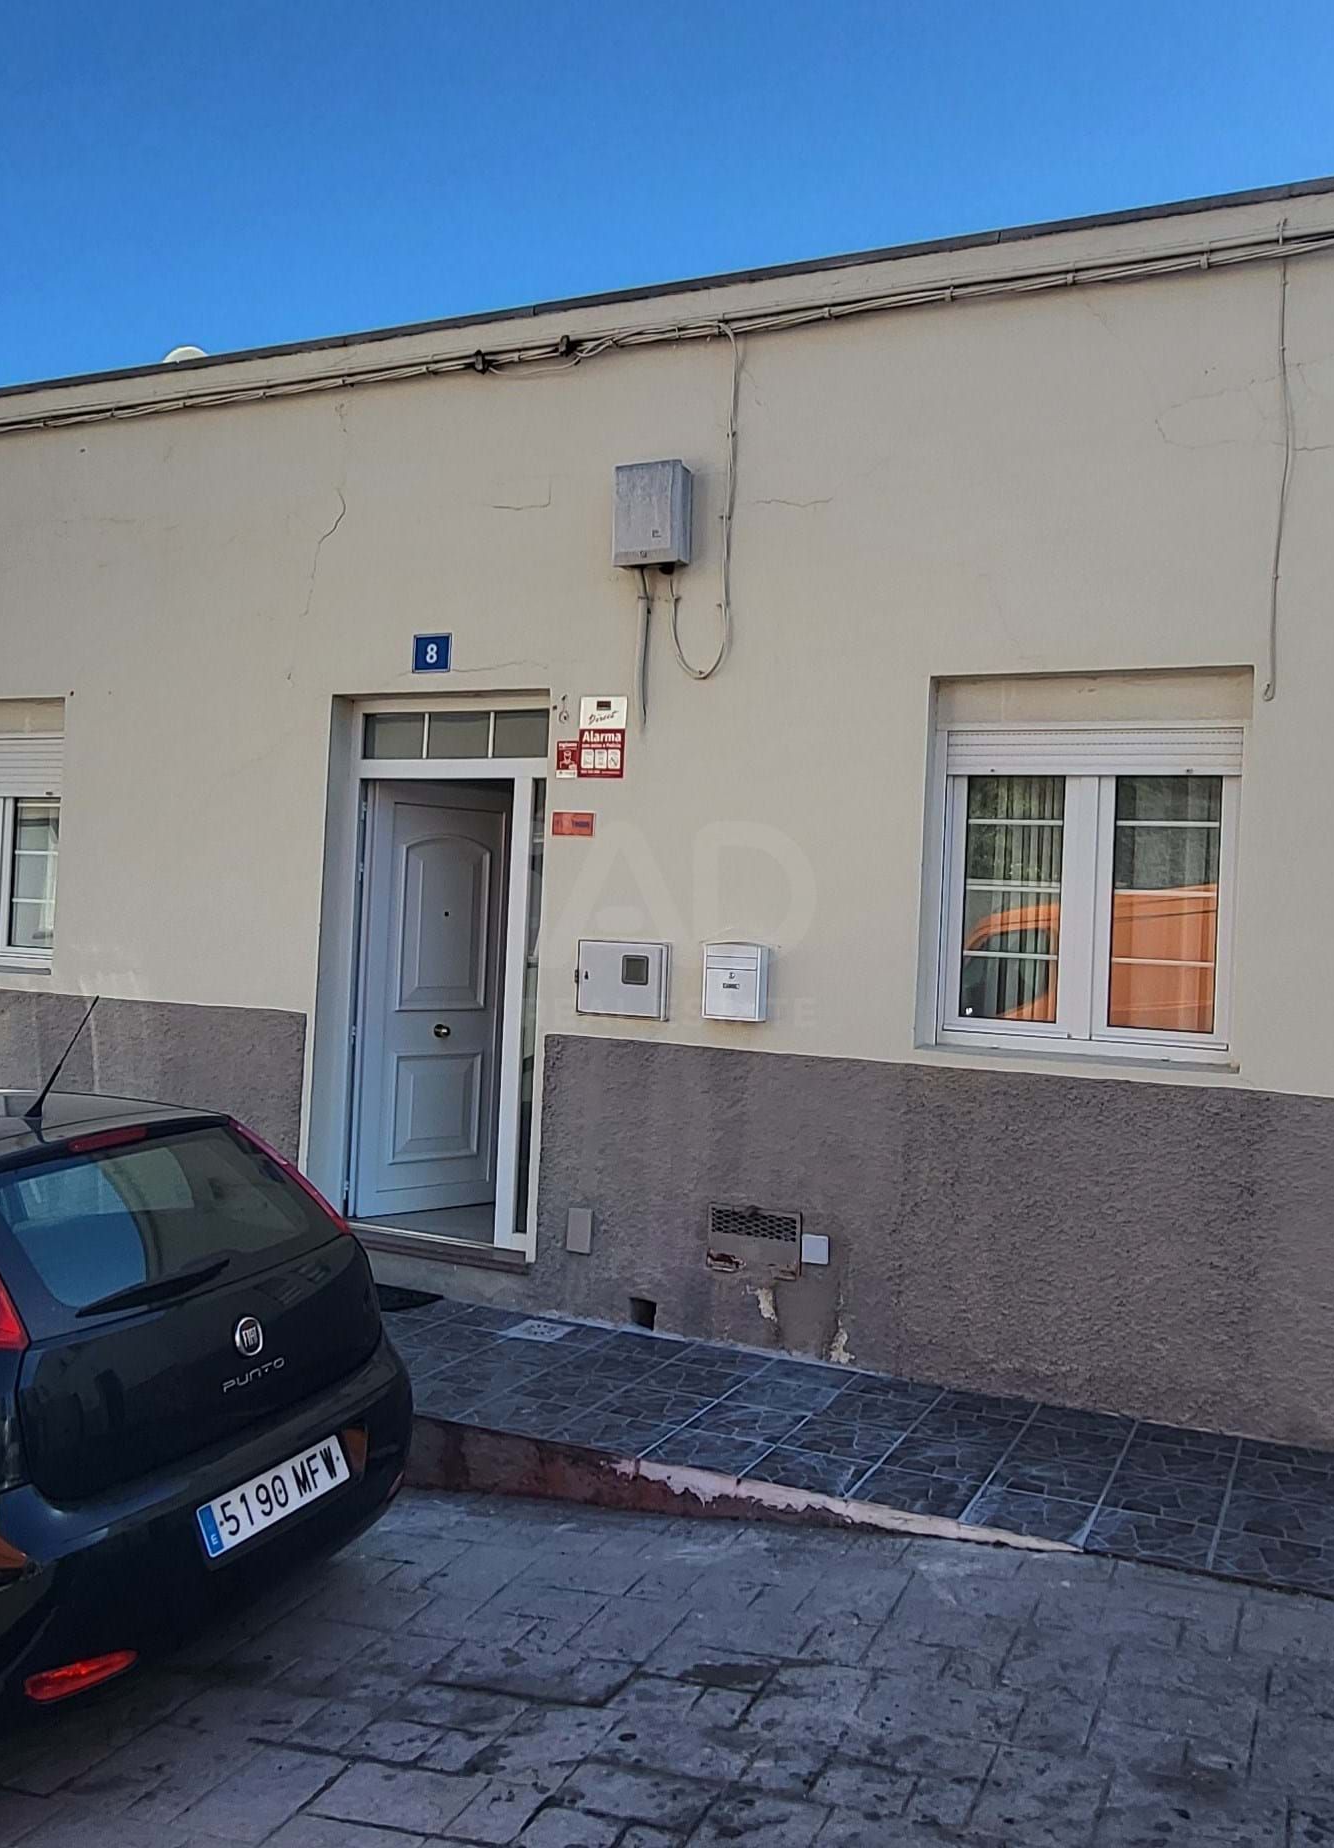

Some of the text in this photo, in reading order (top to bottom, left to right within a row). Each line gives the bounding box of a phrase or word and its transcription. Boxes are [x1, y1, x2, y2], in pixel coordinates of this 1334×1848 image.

[425, 643, 438, 664] 8
[582, 730, 622, 743] Alarma
[222, 1357, 285, 1393] PUNTO
[219, 1445, 338, 1537] 5190 MFW
